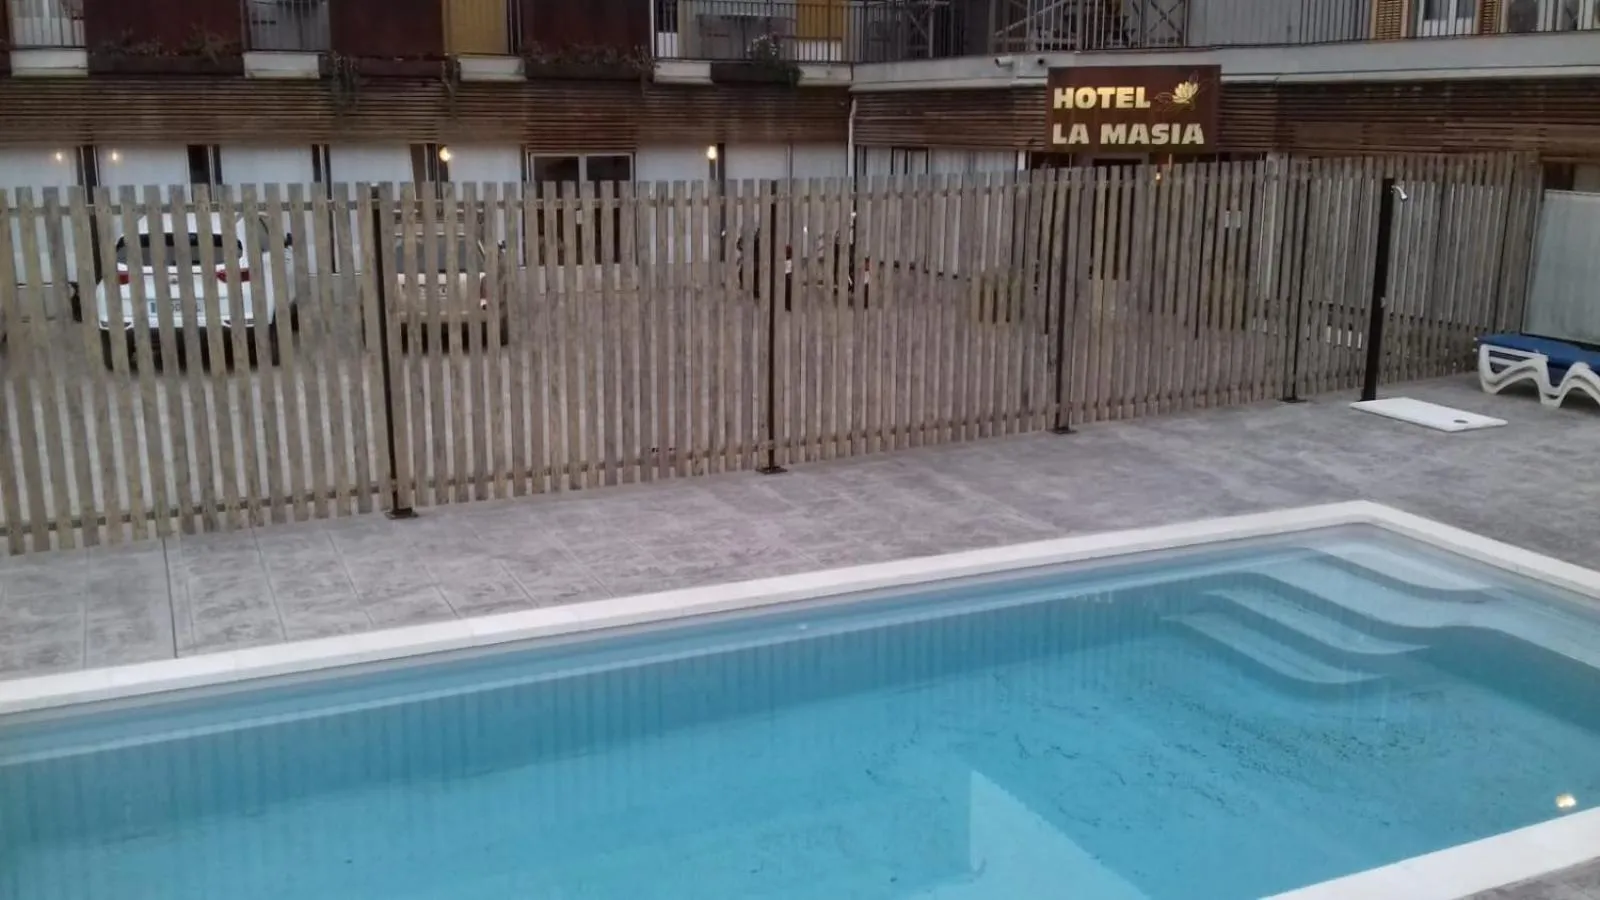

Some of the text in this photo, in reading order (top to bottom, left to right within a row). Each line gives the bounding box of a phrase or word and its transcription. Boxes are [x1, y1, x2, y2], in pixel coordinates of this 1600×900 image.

[1053, 87, 1151, 109] HOTEL
[1052, 123, 1204, 145] LA MASIA
